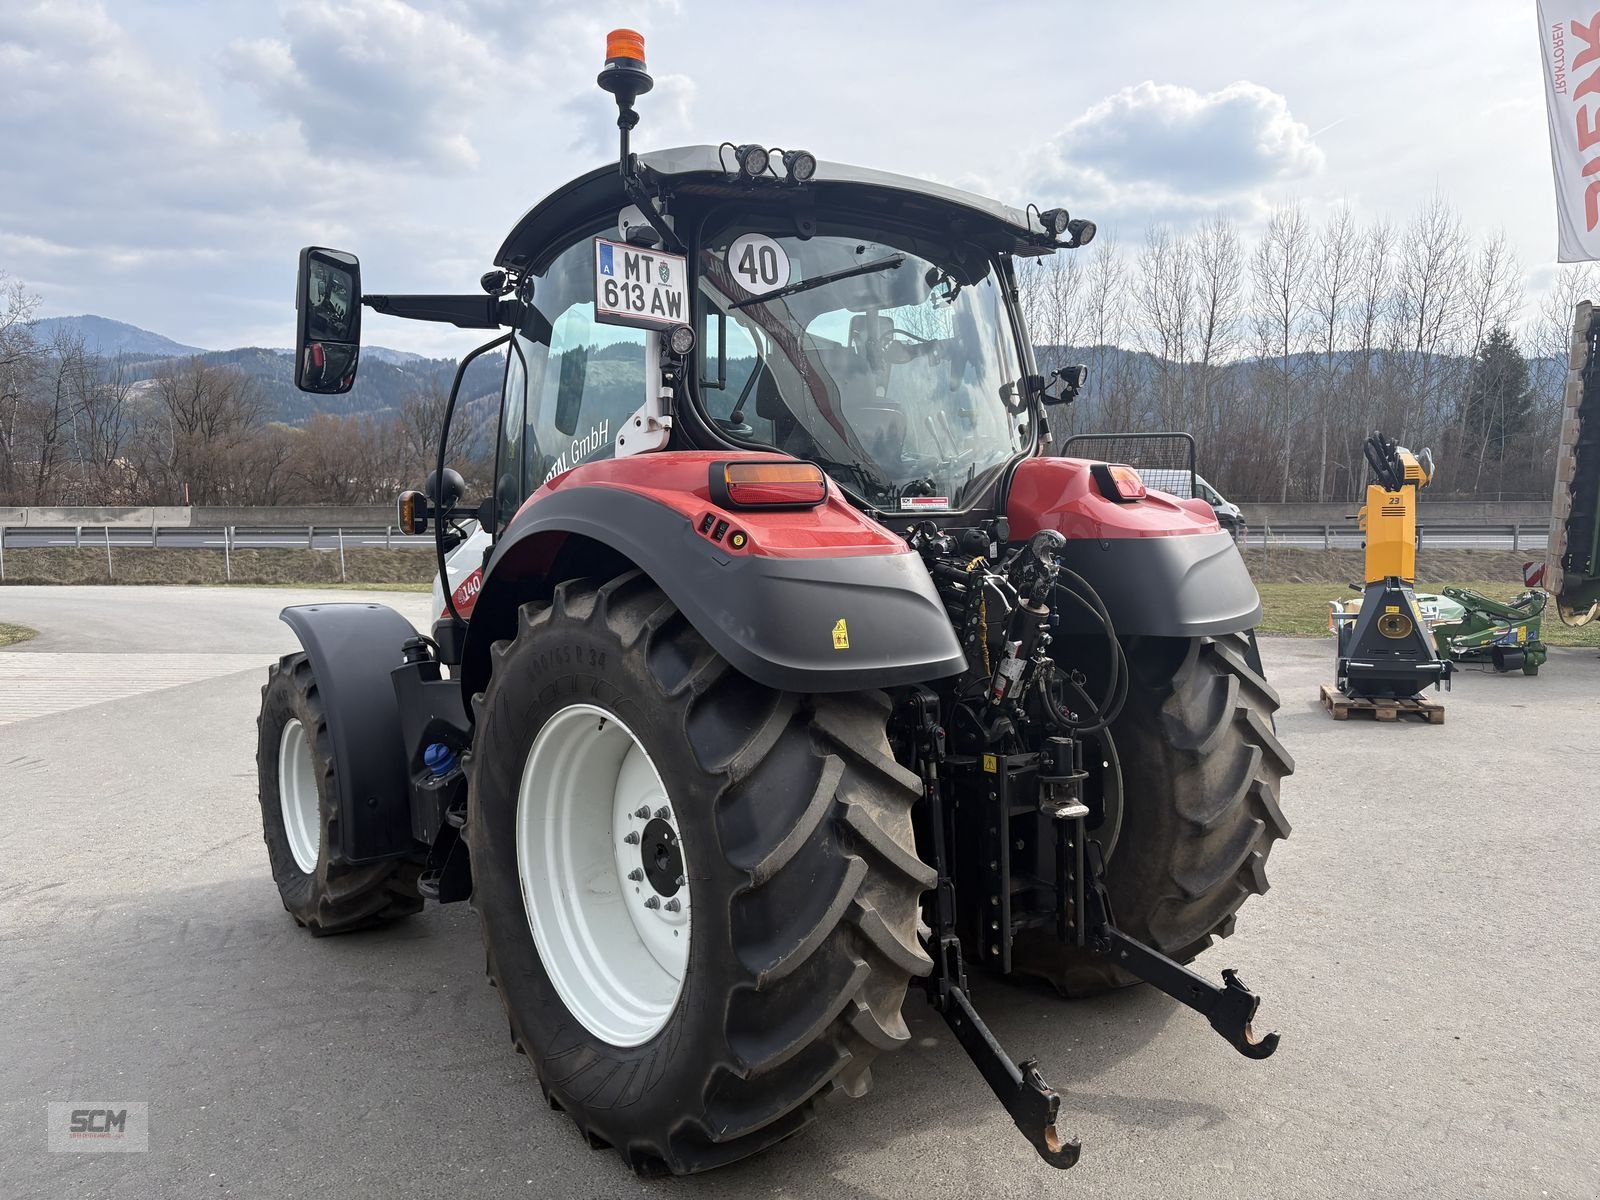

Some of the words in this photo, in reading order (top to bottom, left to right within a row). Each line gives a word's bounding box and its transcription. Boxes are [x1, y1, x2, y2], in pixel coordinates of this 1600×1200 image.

[603, 264, 611, 274] A
[624, 251, 654, 284] MT
[738, 243, 779, 286] 40
[604, 278, 646, 312] 613
[650, 287, 682, 319] AW
[571, 418, 609, 464] GmbH
[1388, 497, 1400, 505] 23
